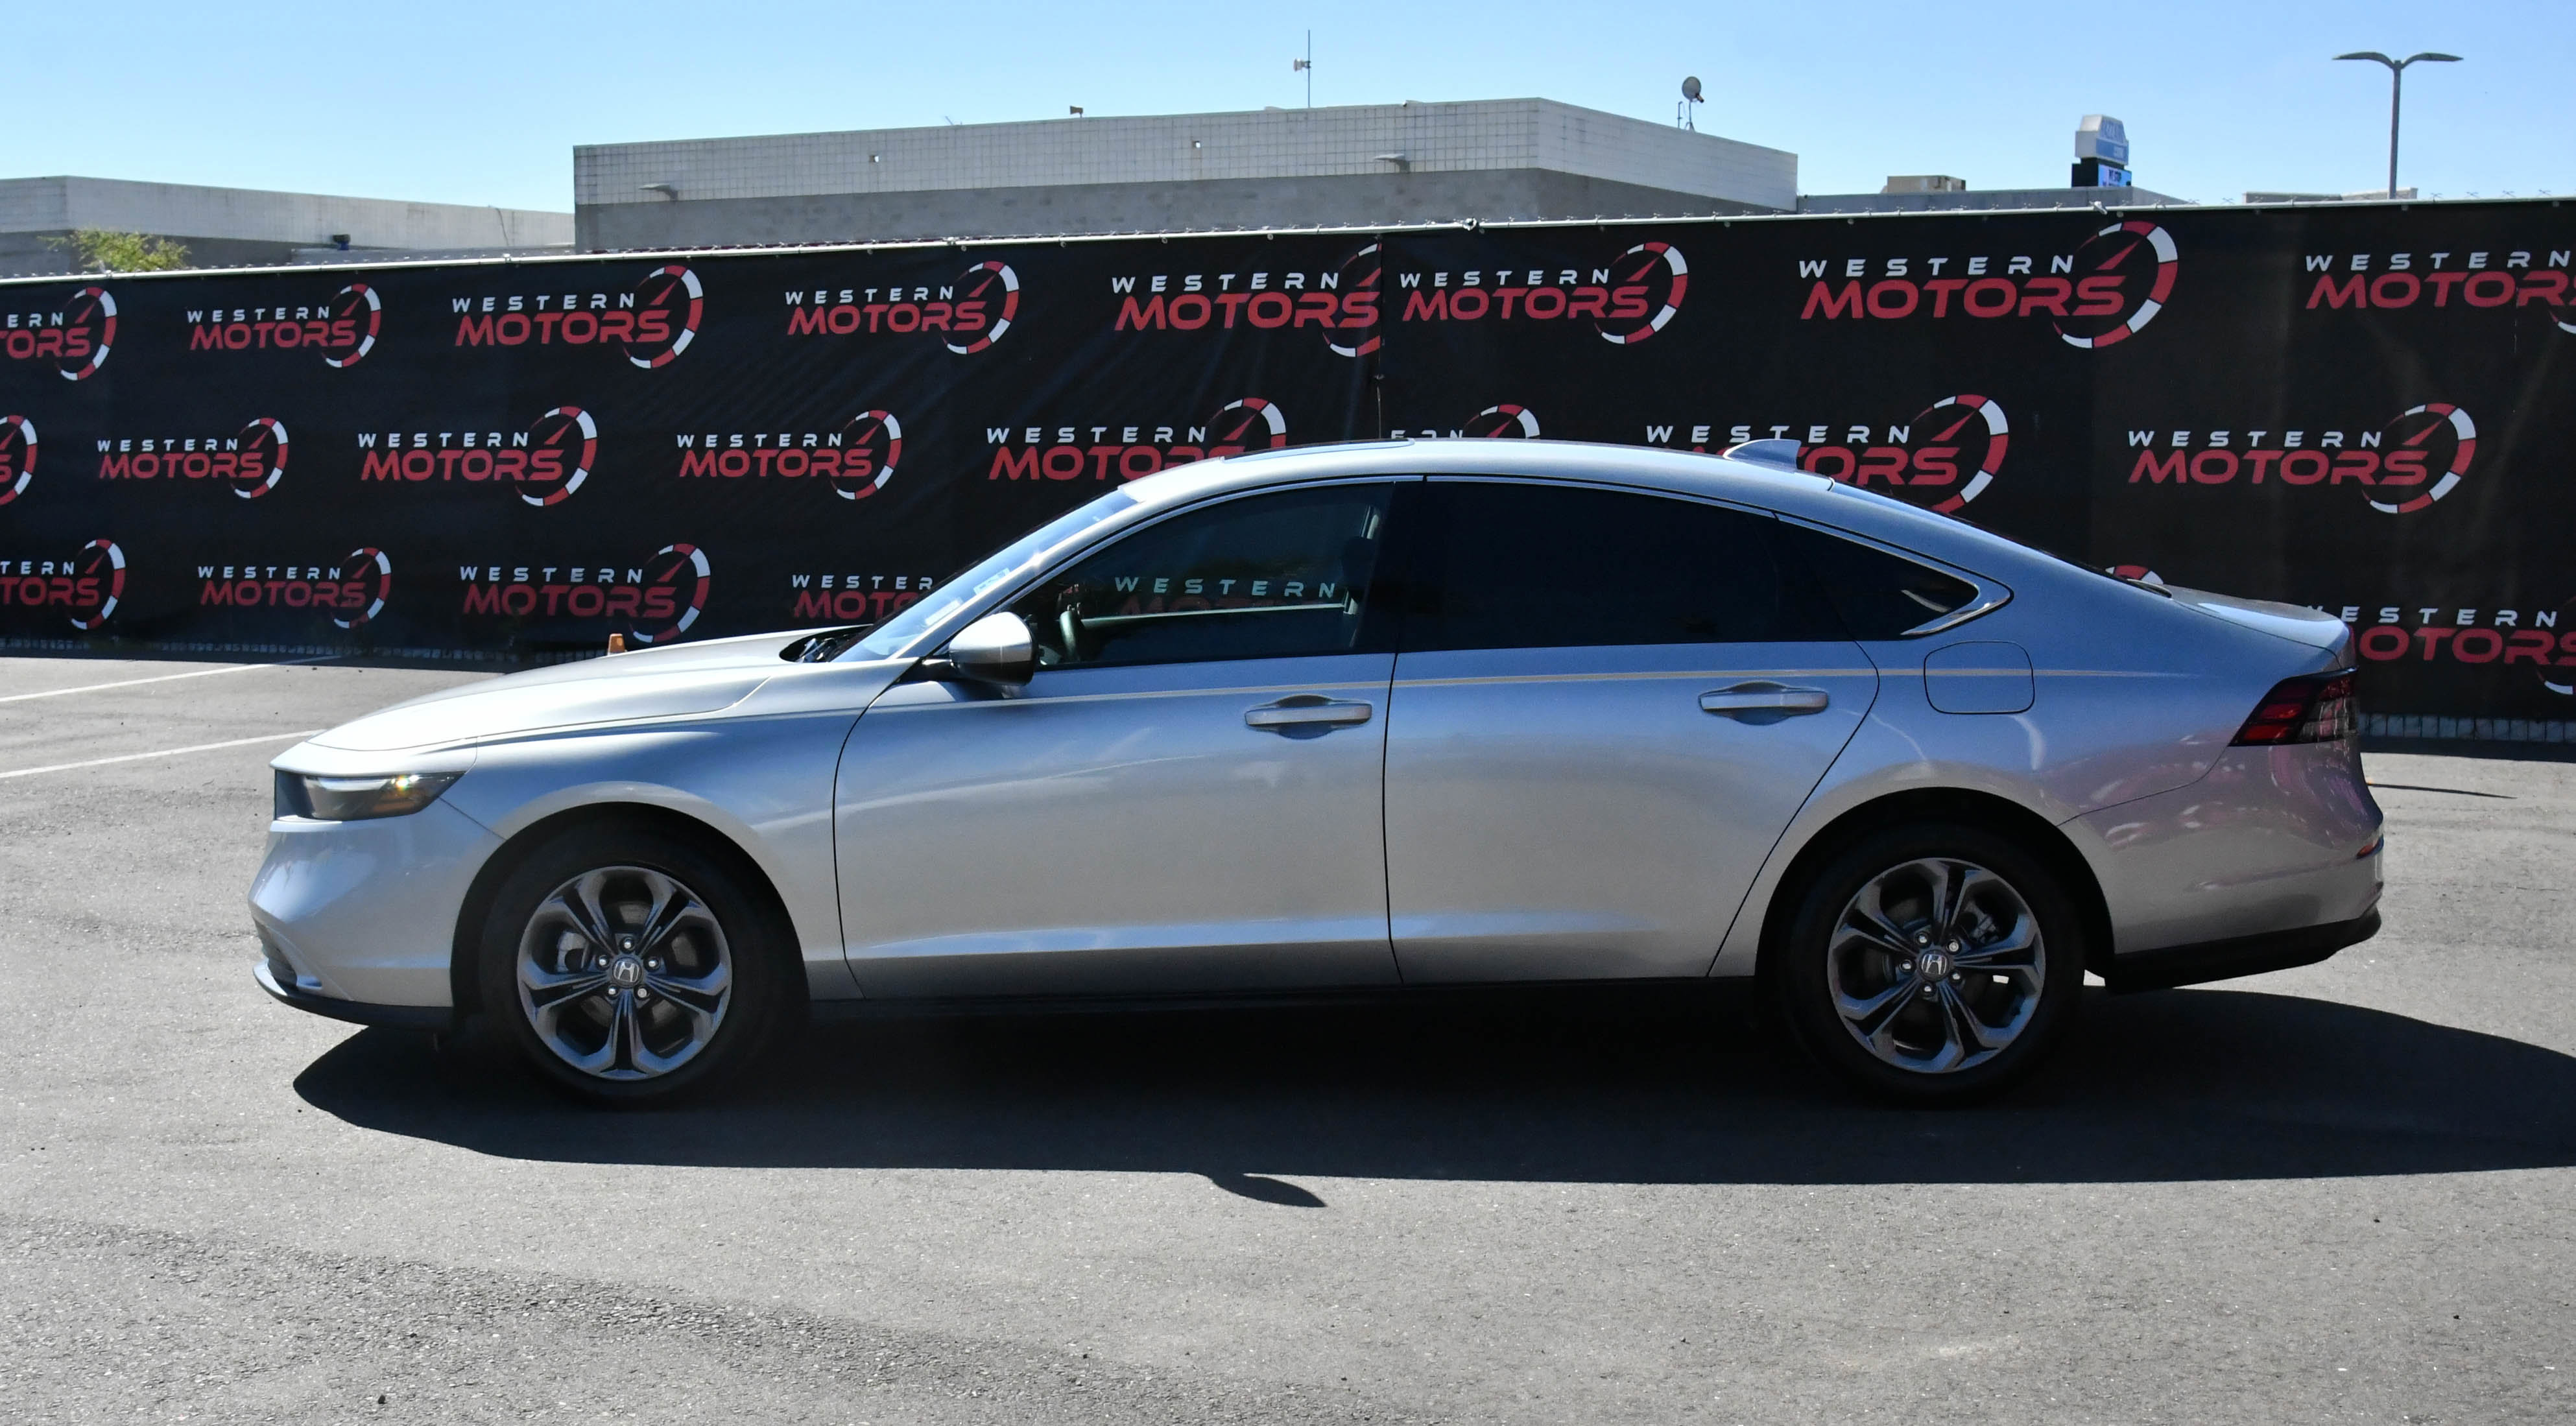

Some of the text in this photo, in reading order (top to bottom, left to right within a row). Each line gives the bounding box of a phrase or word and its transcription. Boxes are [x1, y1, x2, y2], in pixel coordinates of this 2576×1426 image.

[1799, 255, 2073, 278] WESTERN
[2306, 250, 2570, 272] WESTERN
[1112, 272, 1339, 294] WESTERN
[1400, 268, 1609, 289] WESTERN
[2306, 270, 2576, 309] MOTOR
[452, 292, 634, 313] WESTERN
[785, 285, 953, 305] WESTERN
[1402, 285, 1649, 322] MOTORS
[1800, 274, 2126, 320] MOTORS
[187, 306, 329, 323] WESTERN
[788, 300, 986, 335] MOTORS
[1115, 291, 1381, 331] MOTORS
[191, 319, 356, 350] MOTORS
[456, 309, 670, 346] MOTORS
[0, 326, 91, 359] ORS
[97, 438, 238, 452] WESTERN
[358, 432, 529, 448] WESTERN
[676, 433, 842, 448] WESTERN
[986, 426, 1206, 444] WESTERN
[1647, 425, 1910, 444] WESTERN
[2129, 431, 2381, 447] WESTERN
[99, 451, 264, 479] MOTORS
[361, 449, 564, 481] MOTORS
[679, 447, 872, 478] MOTORS
[989, 445, 1245, 481] MOTOR
[2129, 449, 2429, 486] MOTORS
[0, 561, 74, 575] TERN
[198, 566, 340, 580] WESTERN
[460, 566, 643, 583] WESTERN
[0, 576, 100, 606] TORS
[201, 580, 365, 607] MOTORS
[793, 575, 933, 590] WESTER
[1115, 576, 1336, 599] WESTERN
[464, 584, 675, 618] MOTORS
[2308, 606, 2558, 627] ESTERN
[2349, 624, 2576, 666] OTOR
